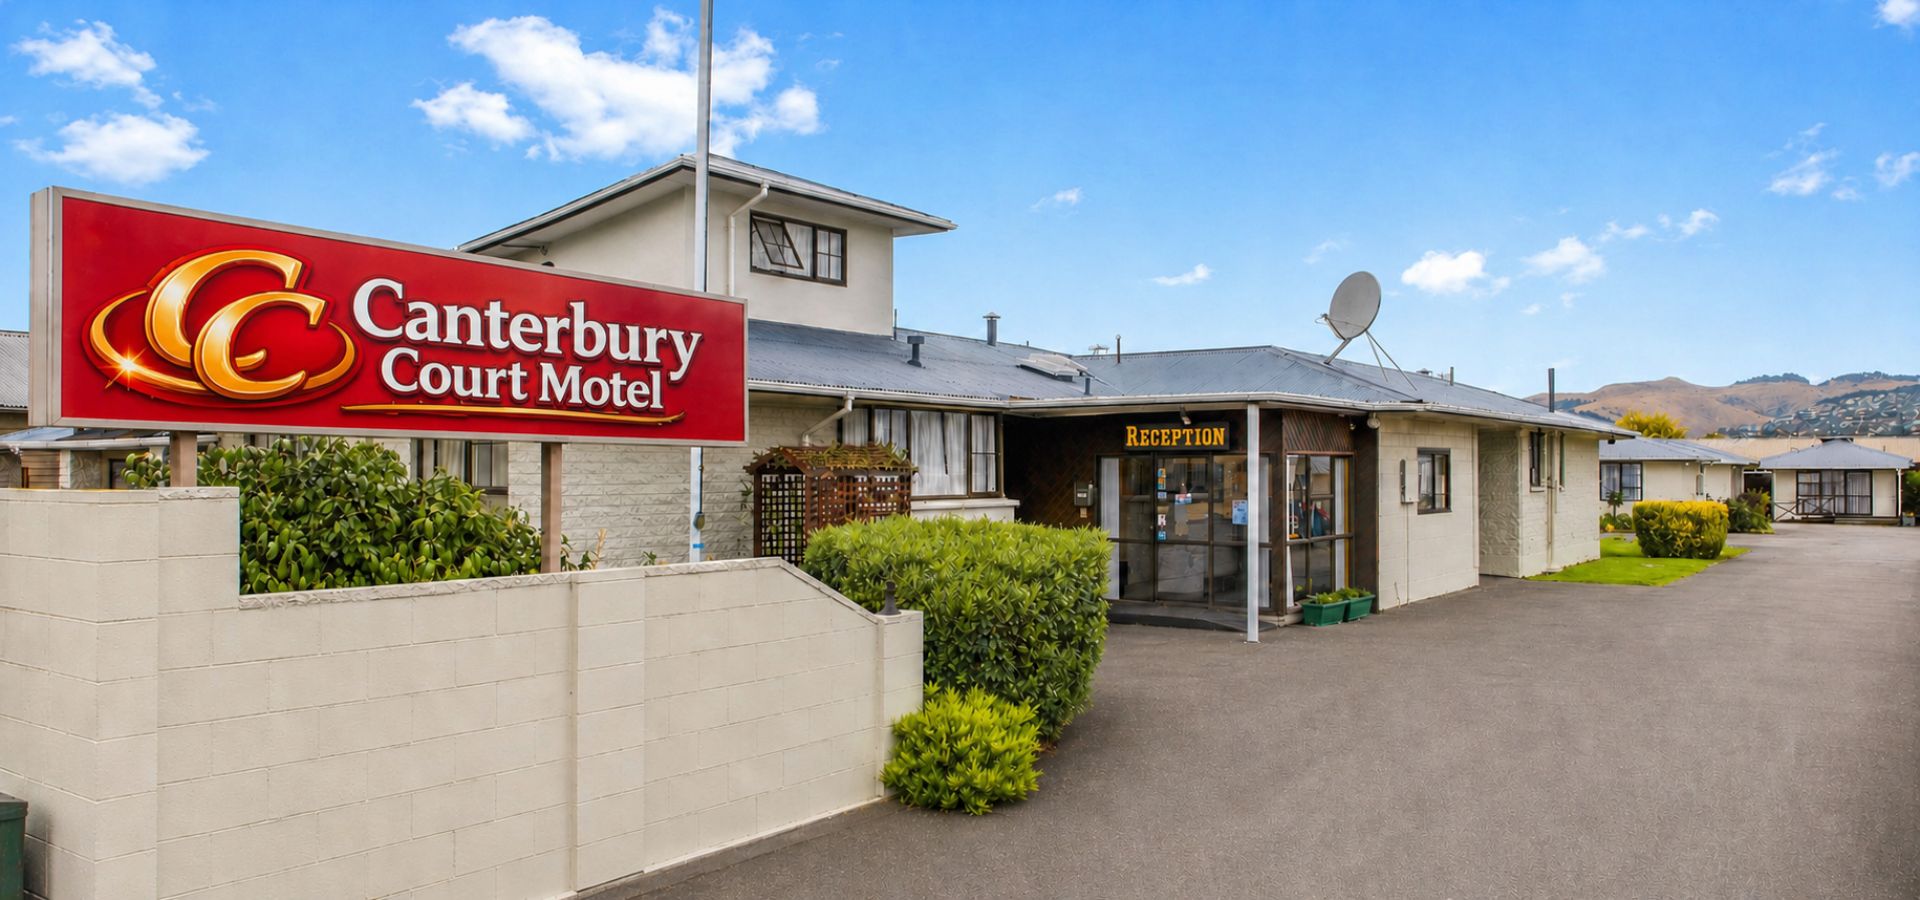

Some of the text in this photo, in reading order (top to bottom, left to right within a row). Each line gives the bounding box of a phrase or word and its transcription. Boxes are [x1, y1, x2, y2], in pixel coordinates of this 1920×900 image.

[353, 278, 702, 382] Canterbury
[381, 347, 664, 409] Court Motel
[1126, 425, 1225, 447] RECEPTION
